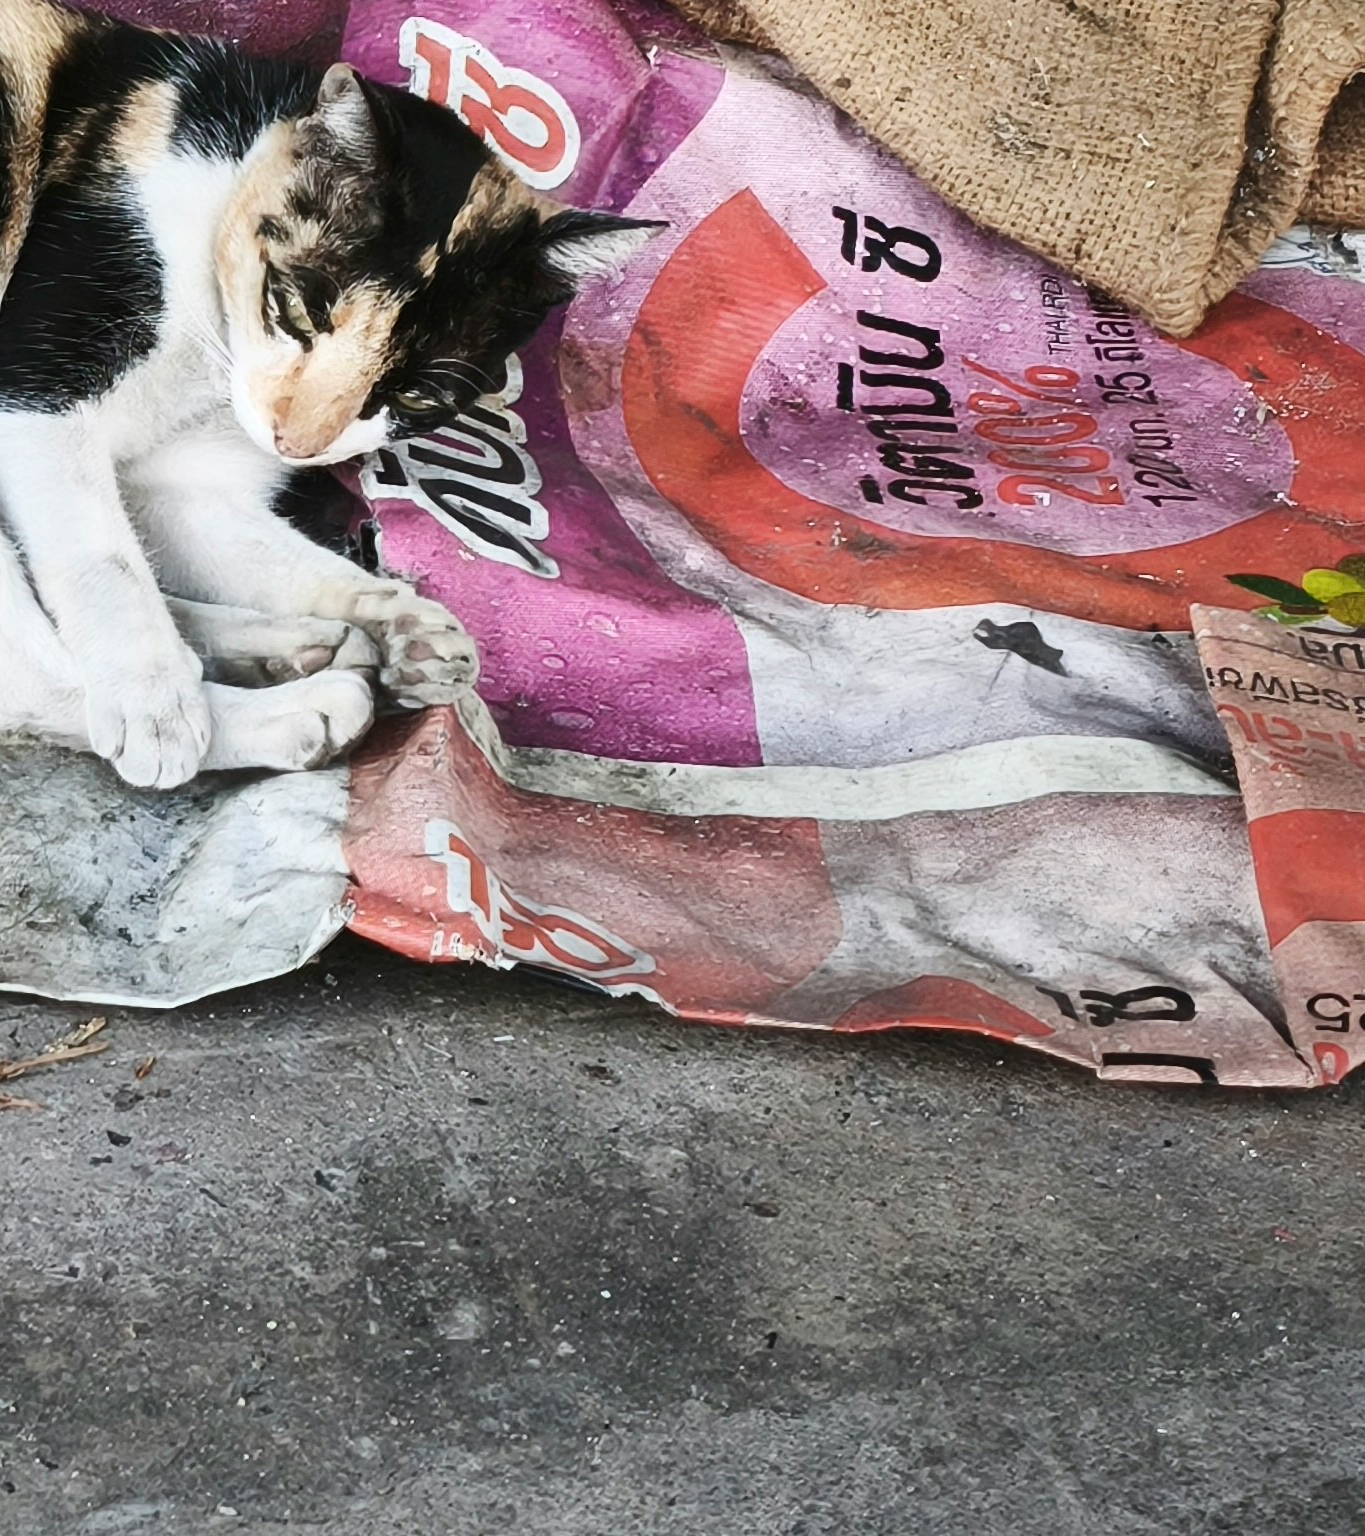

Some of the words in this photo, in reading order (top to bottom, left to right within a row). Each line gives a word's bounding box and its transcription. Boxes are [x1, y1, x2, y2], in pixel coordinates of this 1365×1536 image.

[836, 309, 983, 509] วิตามิน
[961, 354, 1125, 506] 200%
